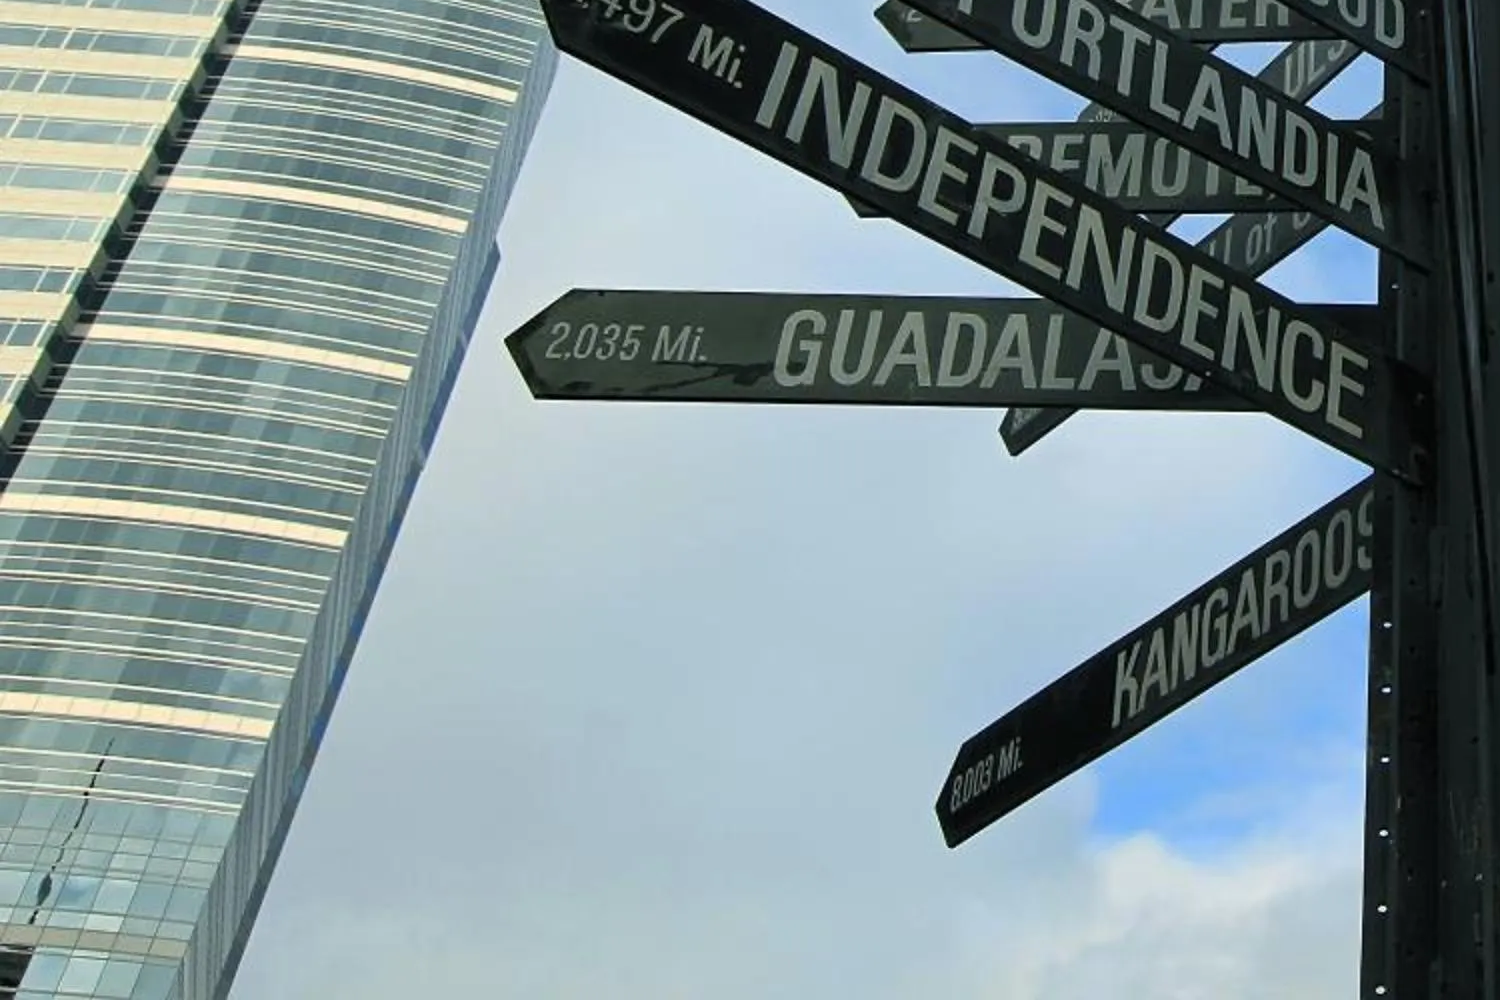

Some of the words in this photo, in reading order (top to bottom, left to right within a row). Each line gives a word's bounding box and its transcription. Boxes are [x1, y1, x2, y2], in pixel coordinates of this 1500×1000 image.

[651, 324, 708, 361] Mi.
[773, 309, 1201, 391] GUADALA
[687, 23, 746, 89] Mi.
[754, 41, 1369, 439] INDEPENDENCE
